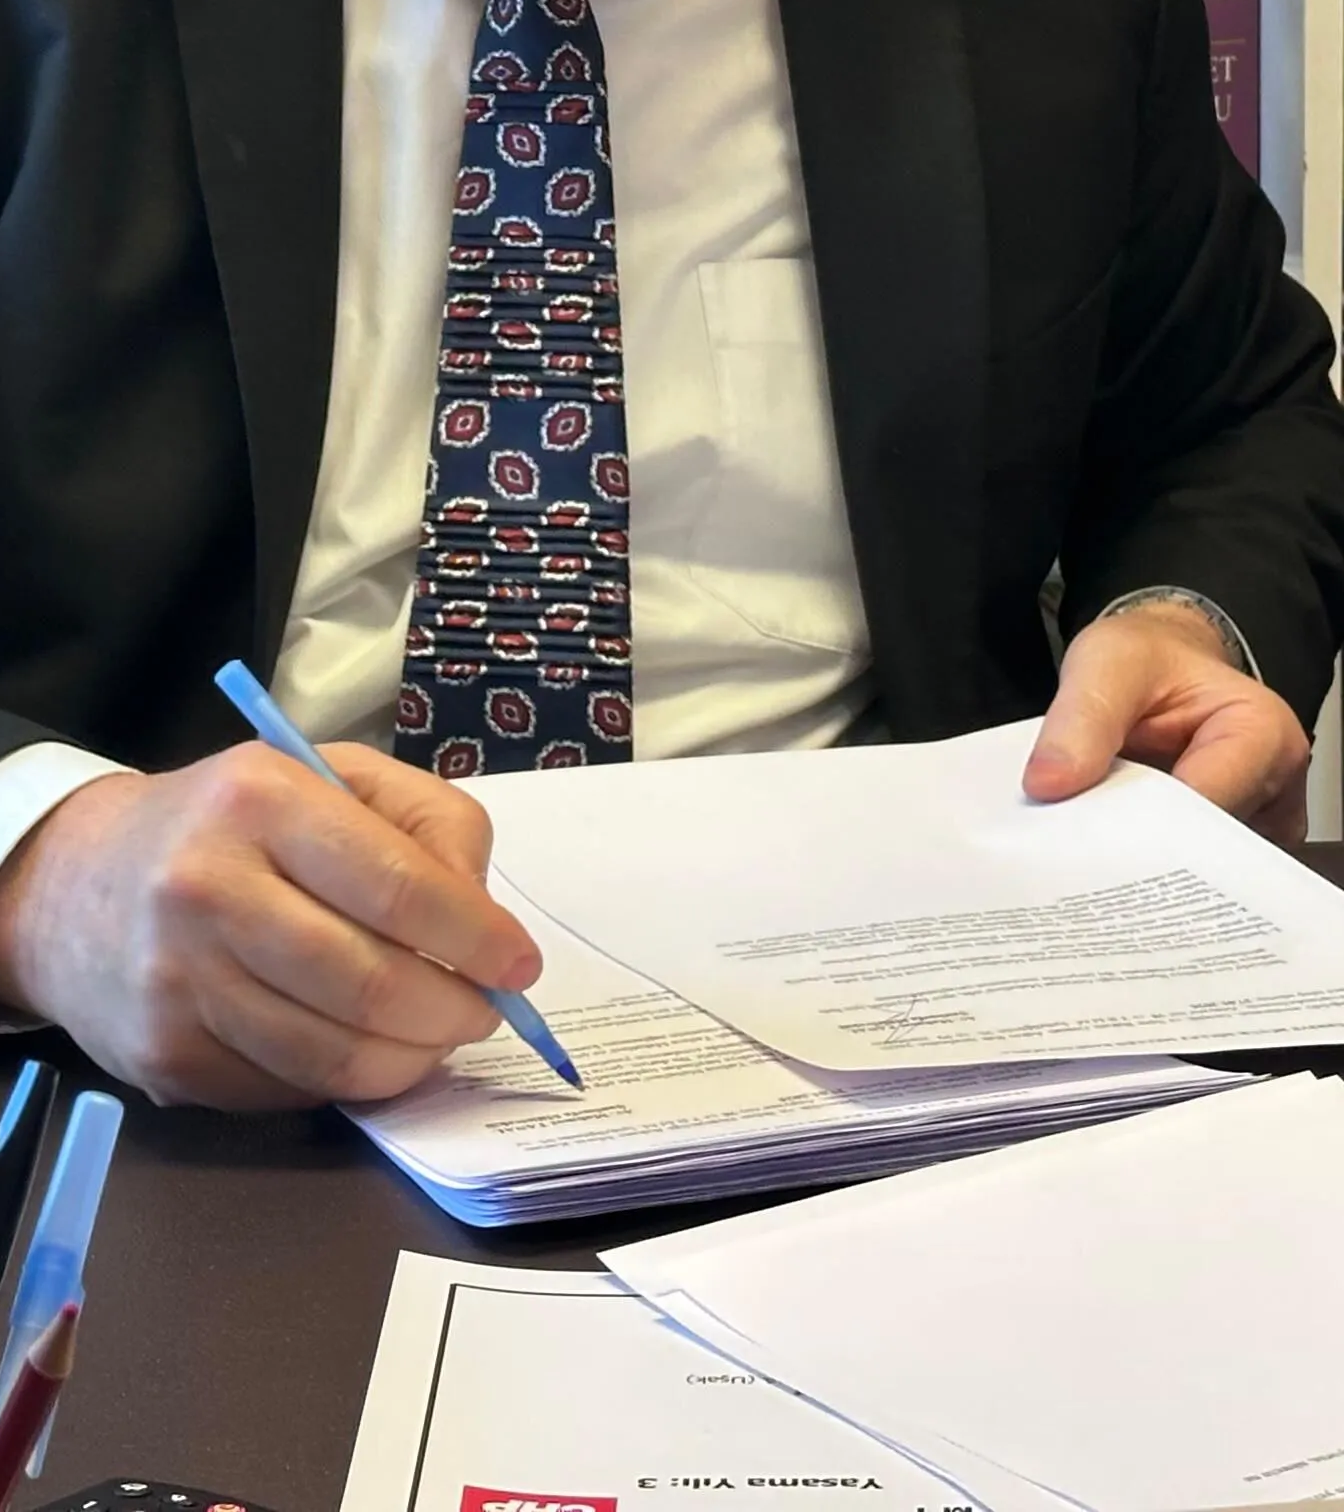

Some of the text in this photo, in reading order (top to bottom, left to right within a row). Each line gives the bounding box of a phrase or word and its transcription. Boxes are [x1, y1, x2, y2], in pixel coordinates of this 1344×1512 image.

[638, 1477, 883, 1490] Yasama Yılı: 3
